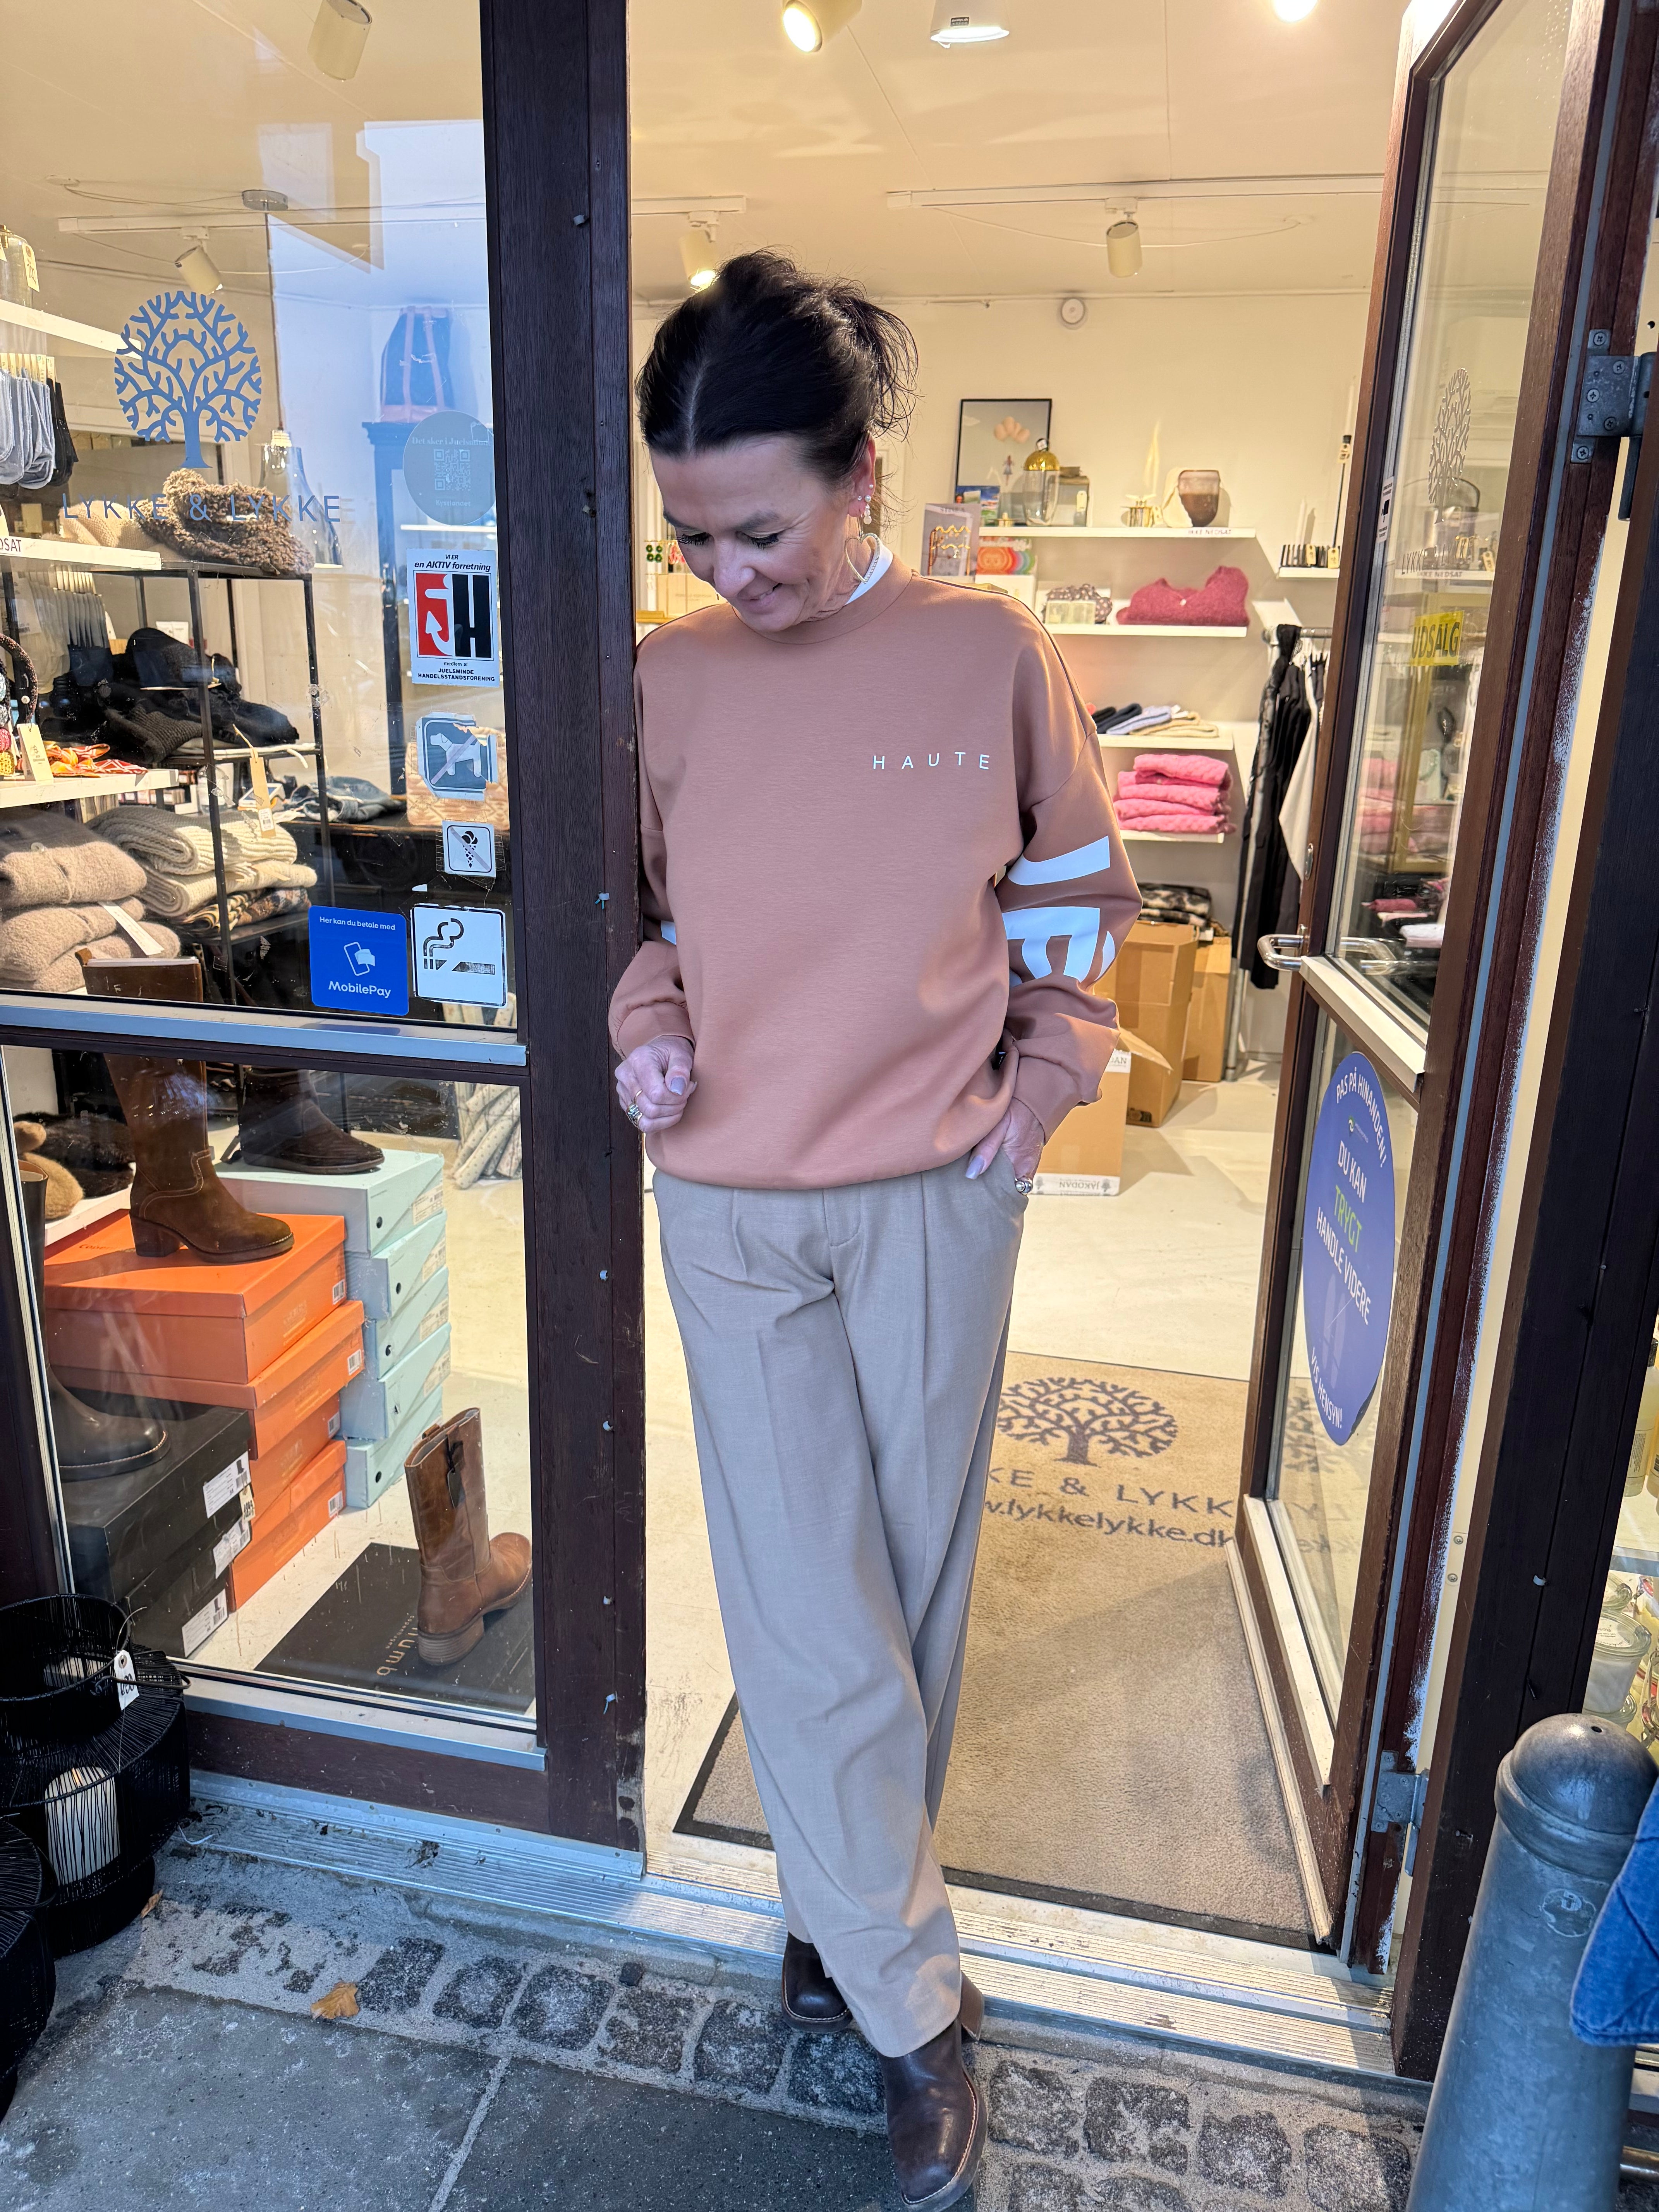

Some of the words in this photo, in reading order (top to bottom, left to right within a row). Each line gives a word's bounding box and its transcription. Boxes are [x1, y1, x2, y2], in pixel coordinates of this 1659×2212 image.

[63, 493, 168, 520] LYKKE
[190, 494, 213, 522] &
[230, 495, 341, 522] LYKKE
[452, 563, 491, 572] forretning
[1411, 622, 1460, 659] UDSALG
[418, 673, 495, 682] HANDELSSTANDSFORENING
[872, 752, 990, 770] HAUTE
[357, 921, 378, 929] betale
[328, 981, 391, 999] MobilePay
[1337, 1075, 1348, 1103] PAS
[1349, 1066, 1357, 1092] PÅ
[1358, 1074, 1386, 1168] HINANDEN!
[1338, 1140, 1350, 1175] DU
[1349, 1158, 1367, 1203] KAN
[1334, 1185, 1362, 1253] TRYGT
[1317, 1207, 1344, 1274] HANDLE
[1345, 1255, 1371, 1326] VIDERE
[1318, 1377, 1342, 1429] HENSYN!
[1060, 1477, 1089, 1497] &
[1117, 1484, 1234, 1518] LYKK
